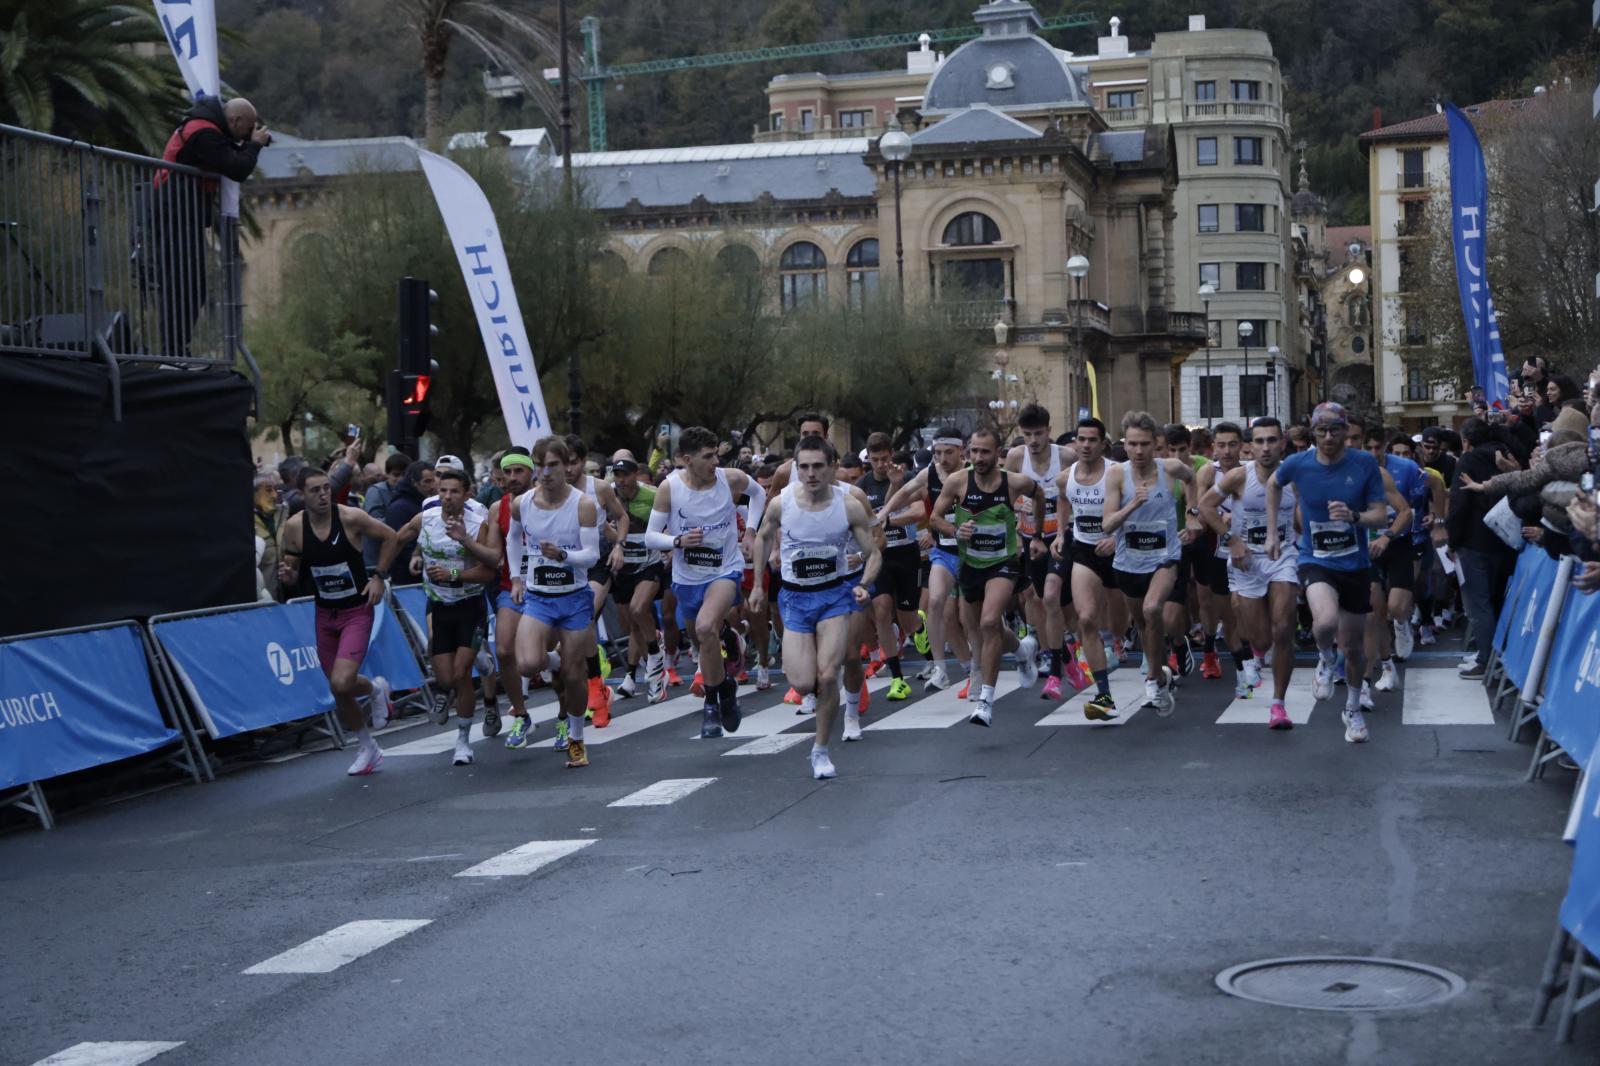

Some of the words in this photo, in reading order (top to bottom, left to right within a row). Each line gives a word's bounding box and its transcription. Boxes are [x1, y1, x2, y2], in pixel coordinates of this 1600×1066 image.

[805, 563, 831, 571] MIKEL
[544, 571, 567, 579] HUGO
[0, 691, 62, 728] URICH
